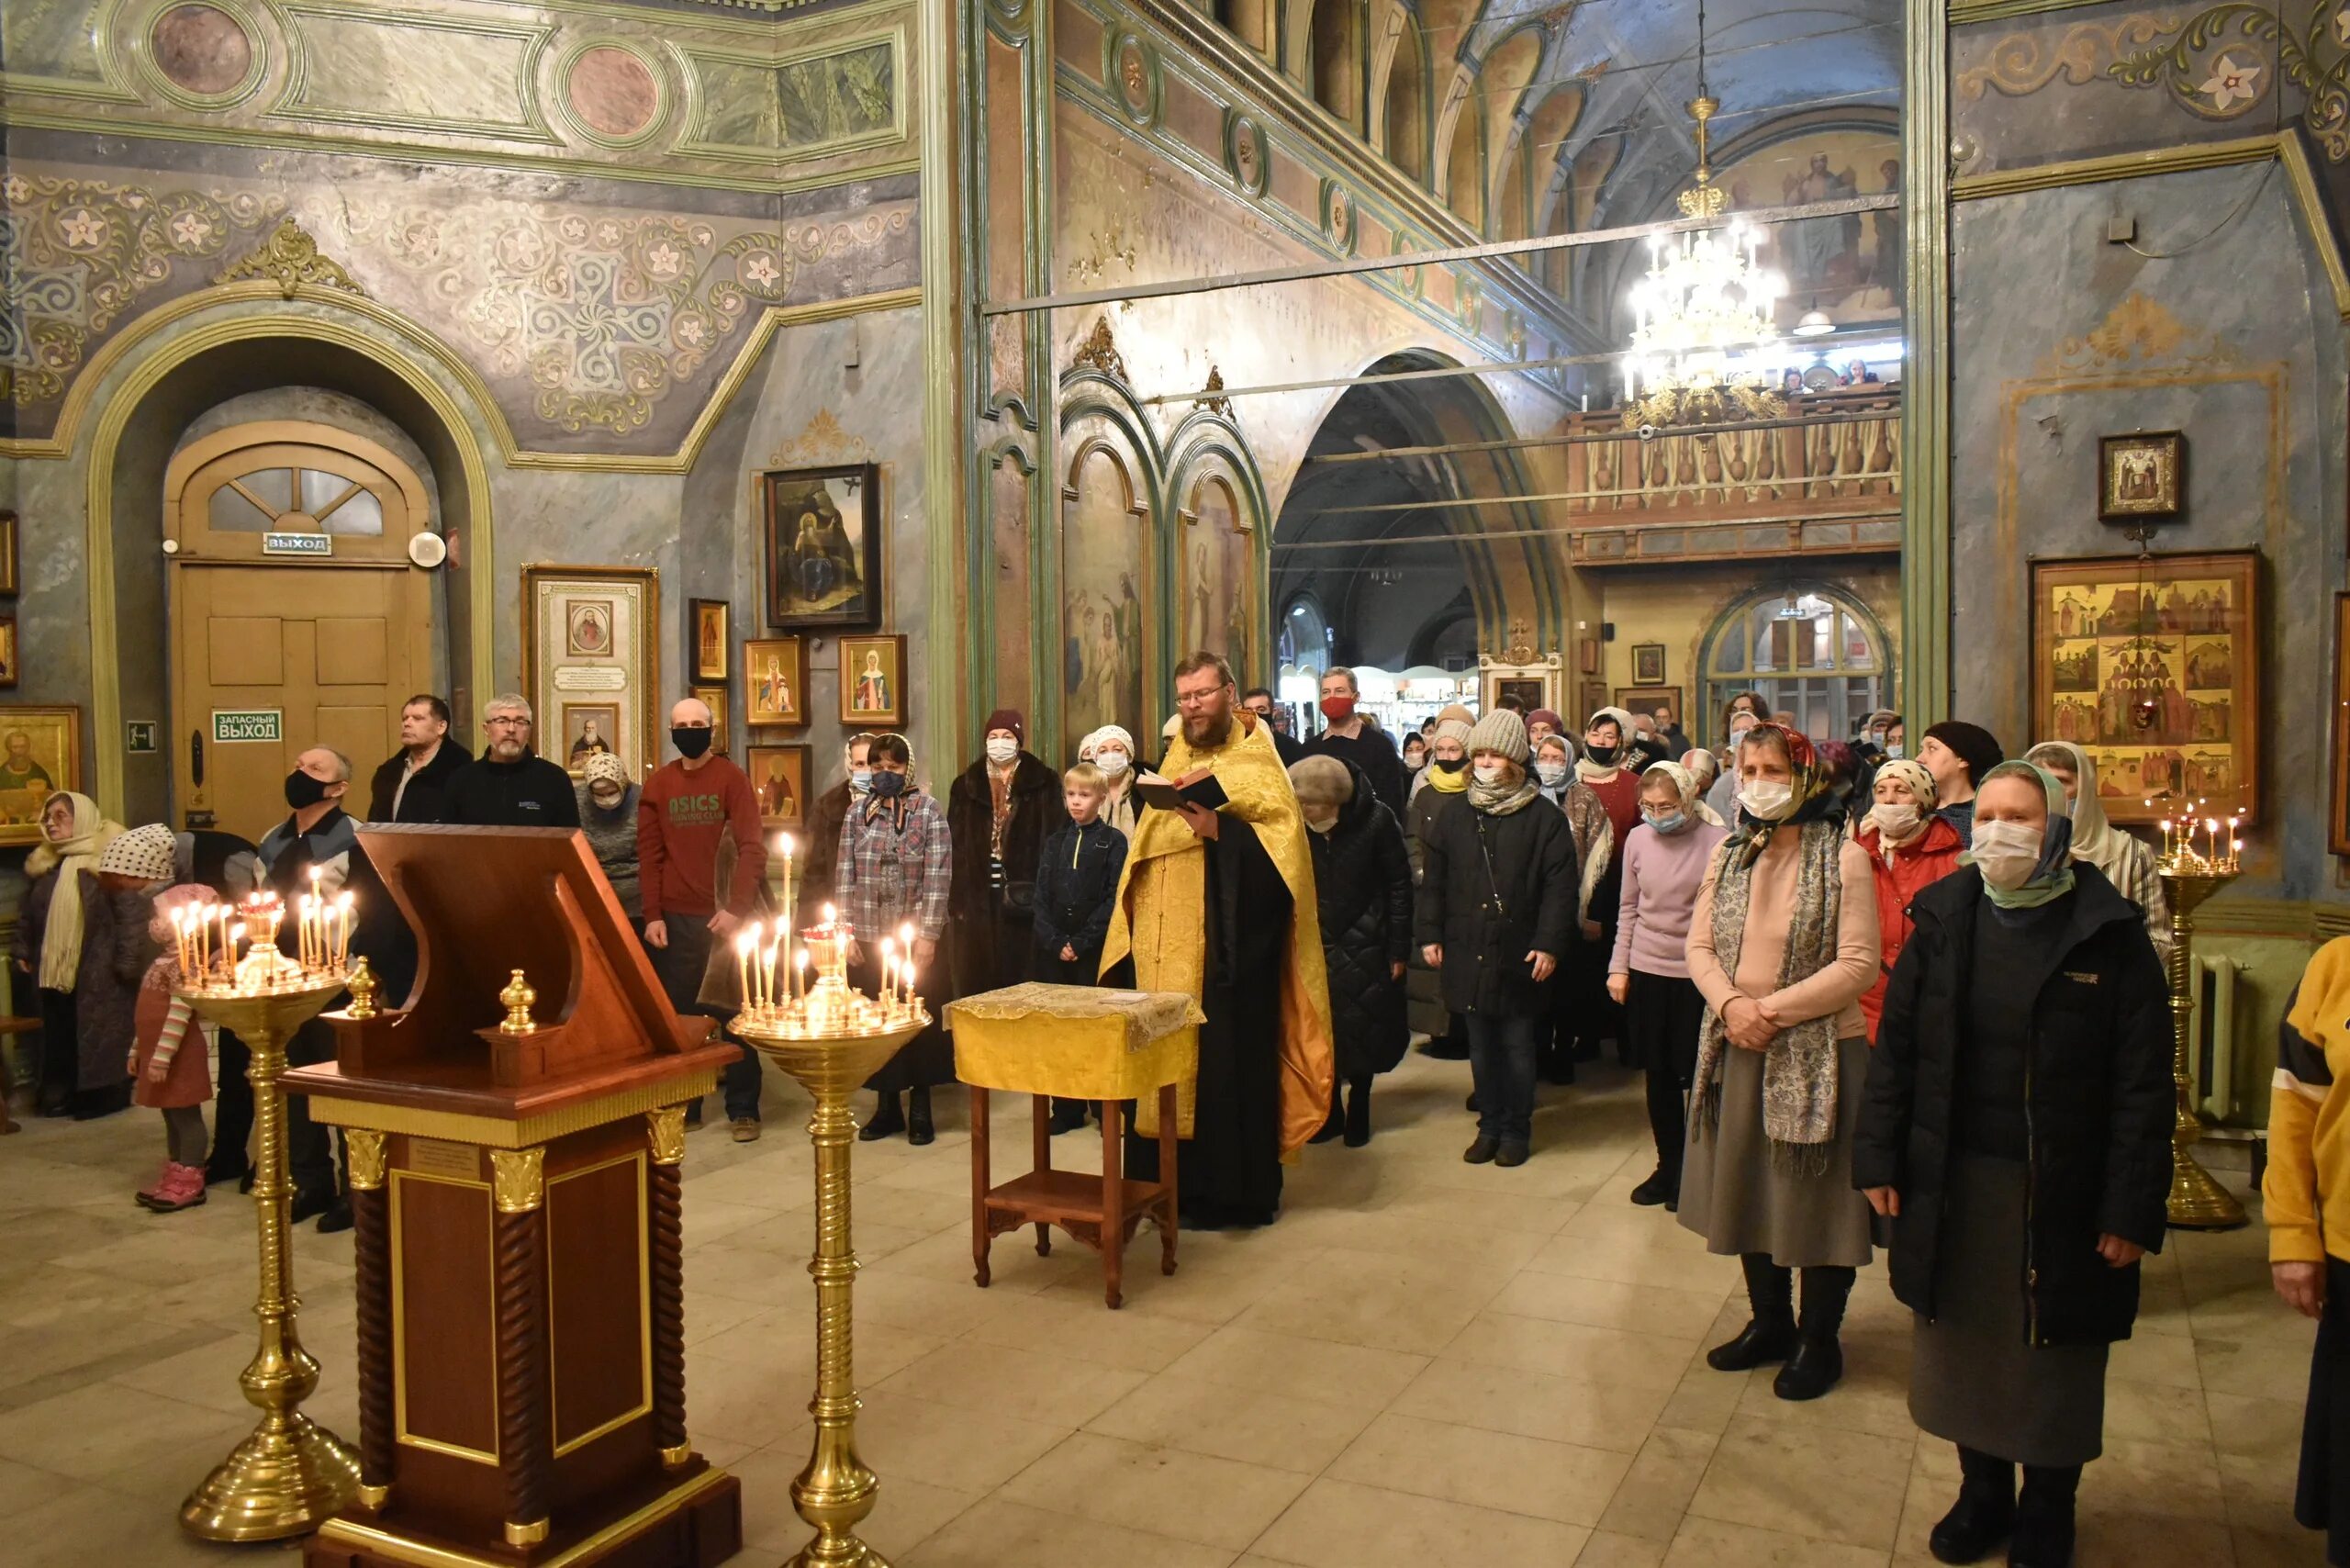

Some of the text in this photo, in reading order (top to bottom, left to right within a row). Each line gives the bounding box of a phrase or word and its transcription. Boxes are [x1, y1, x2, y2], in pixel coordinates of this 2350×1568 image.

[269, 539, 326, 551] ВЫХОД
[219, 715, 275, 724] ЗАПАСНЫЙ
[219, 724, 275, 738] ВЫХОД
